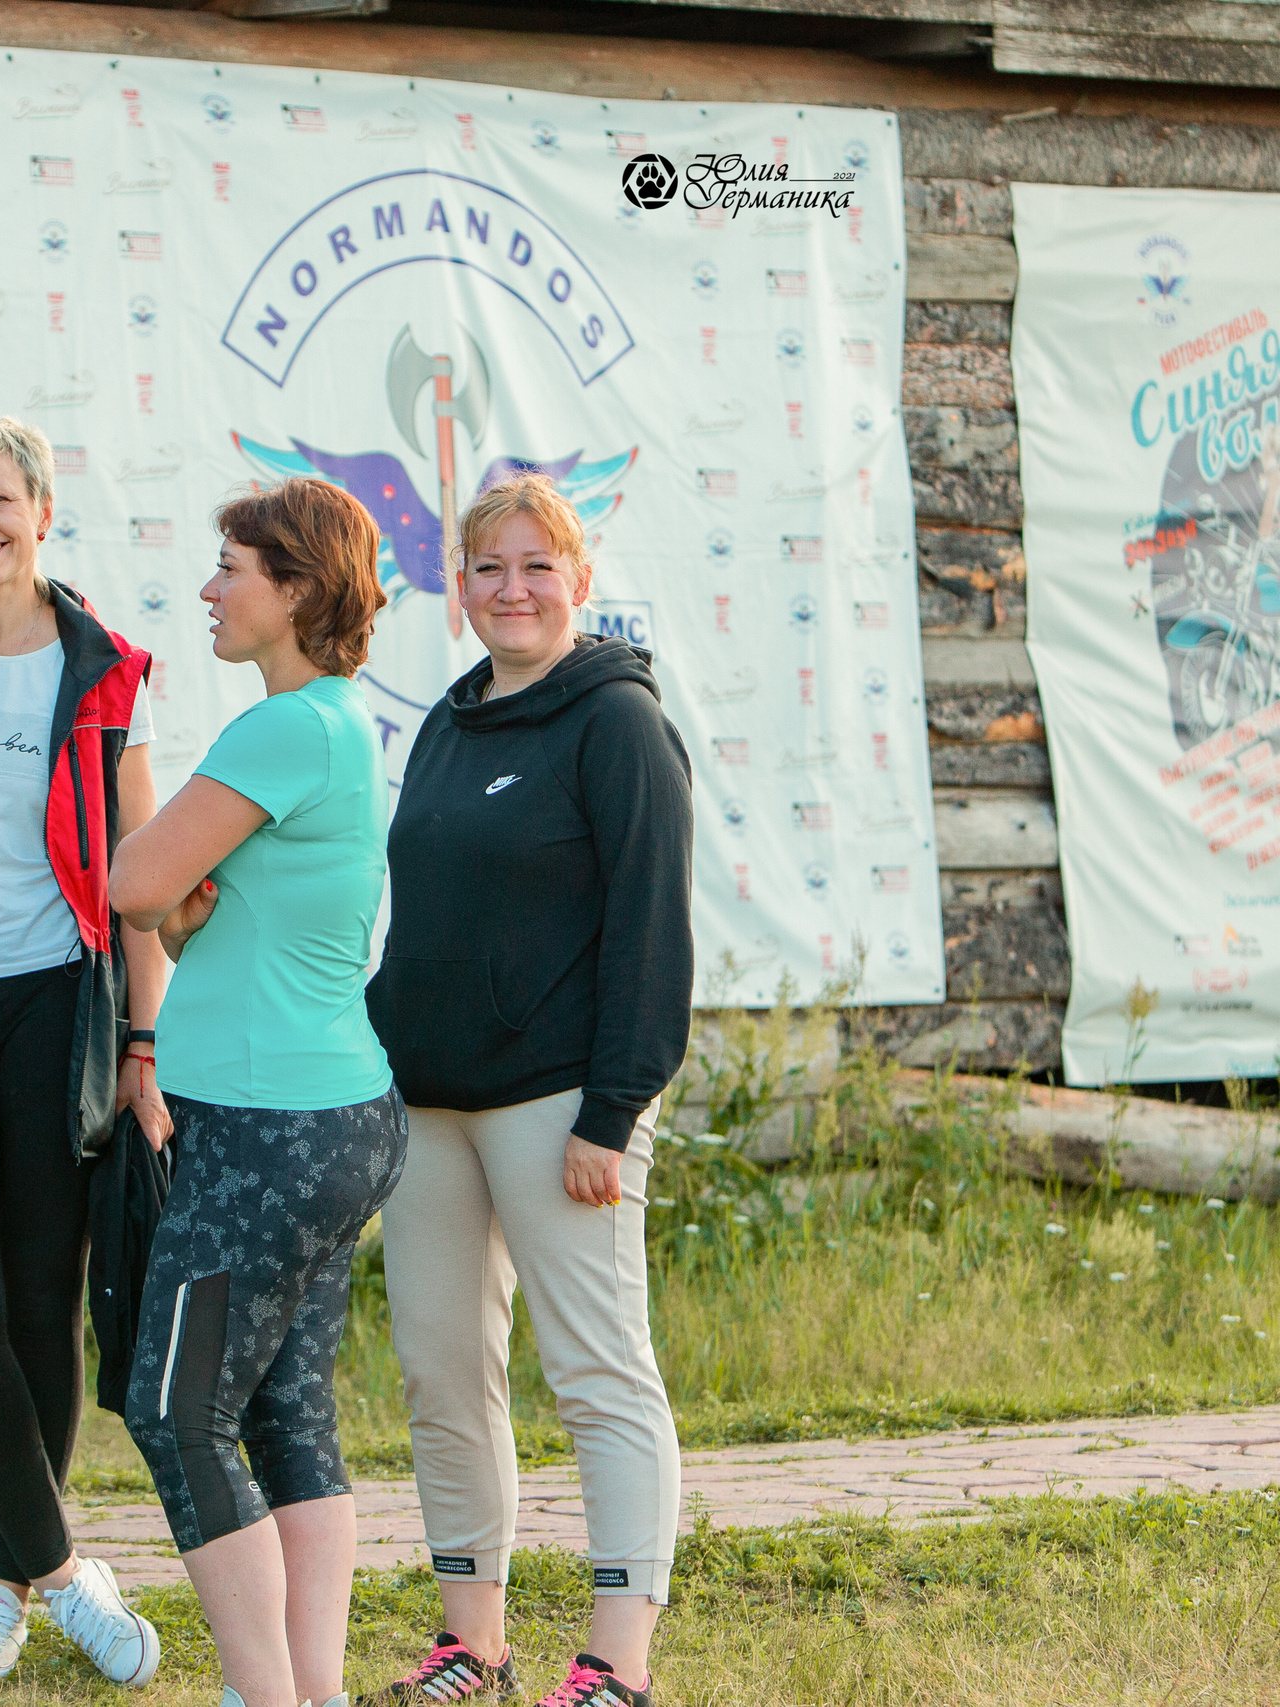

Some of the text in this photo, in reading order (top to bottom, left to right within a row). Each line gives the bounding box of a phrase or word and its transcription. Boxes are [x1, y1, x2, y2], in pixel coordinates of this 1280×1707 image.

[255, 198, 604, 350] NORMANDOS
[1159, 307, 1268, 376] МОТОФЕСТИВАЛЬ
[599, 614, 646, 644] MC
